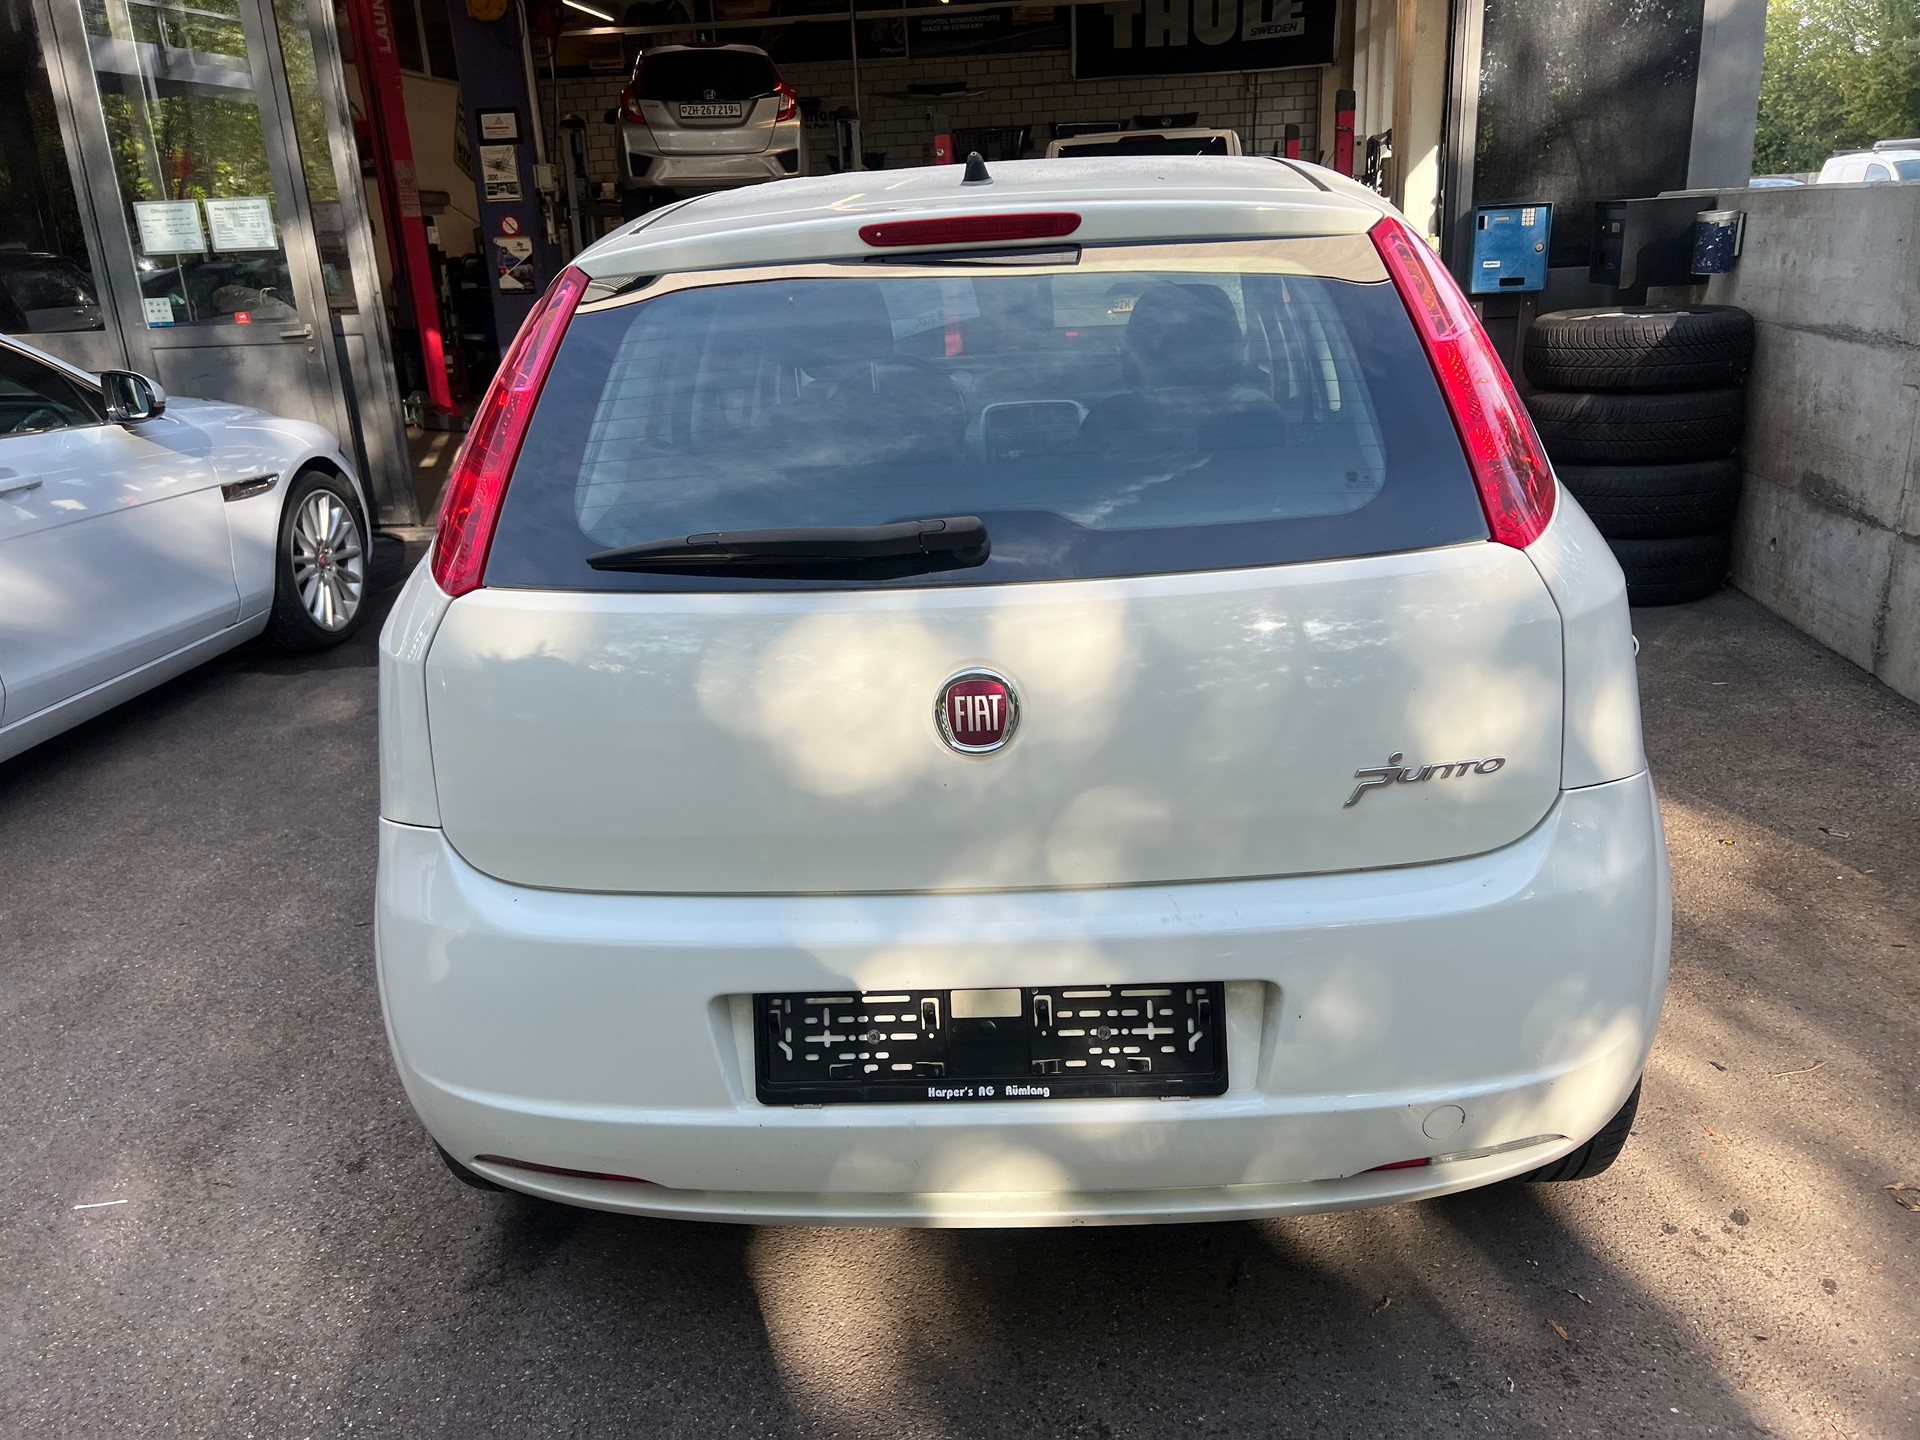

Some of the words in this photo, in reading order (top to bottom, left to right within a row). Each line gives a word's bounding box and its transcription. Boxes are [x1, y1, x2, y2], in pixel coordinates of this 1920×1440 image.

[1104, 0, 1306, 49] THULE
[1250, 22, 1298, 36] SWEDEN
[954, 694, 1002, 732] FIAT
[928, 1086, 974, 1100] Harper's
[978, 1086, 995, 1097] AG
[1005, 1085, 1050, 1098] Rümlang
